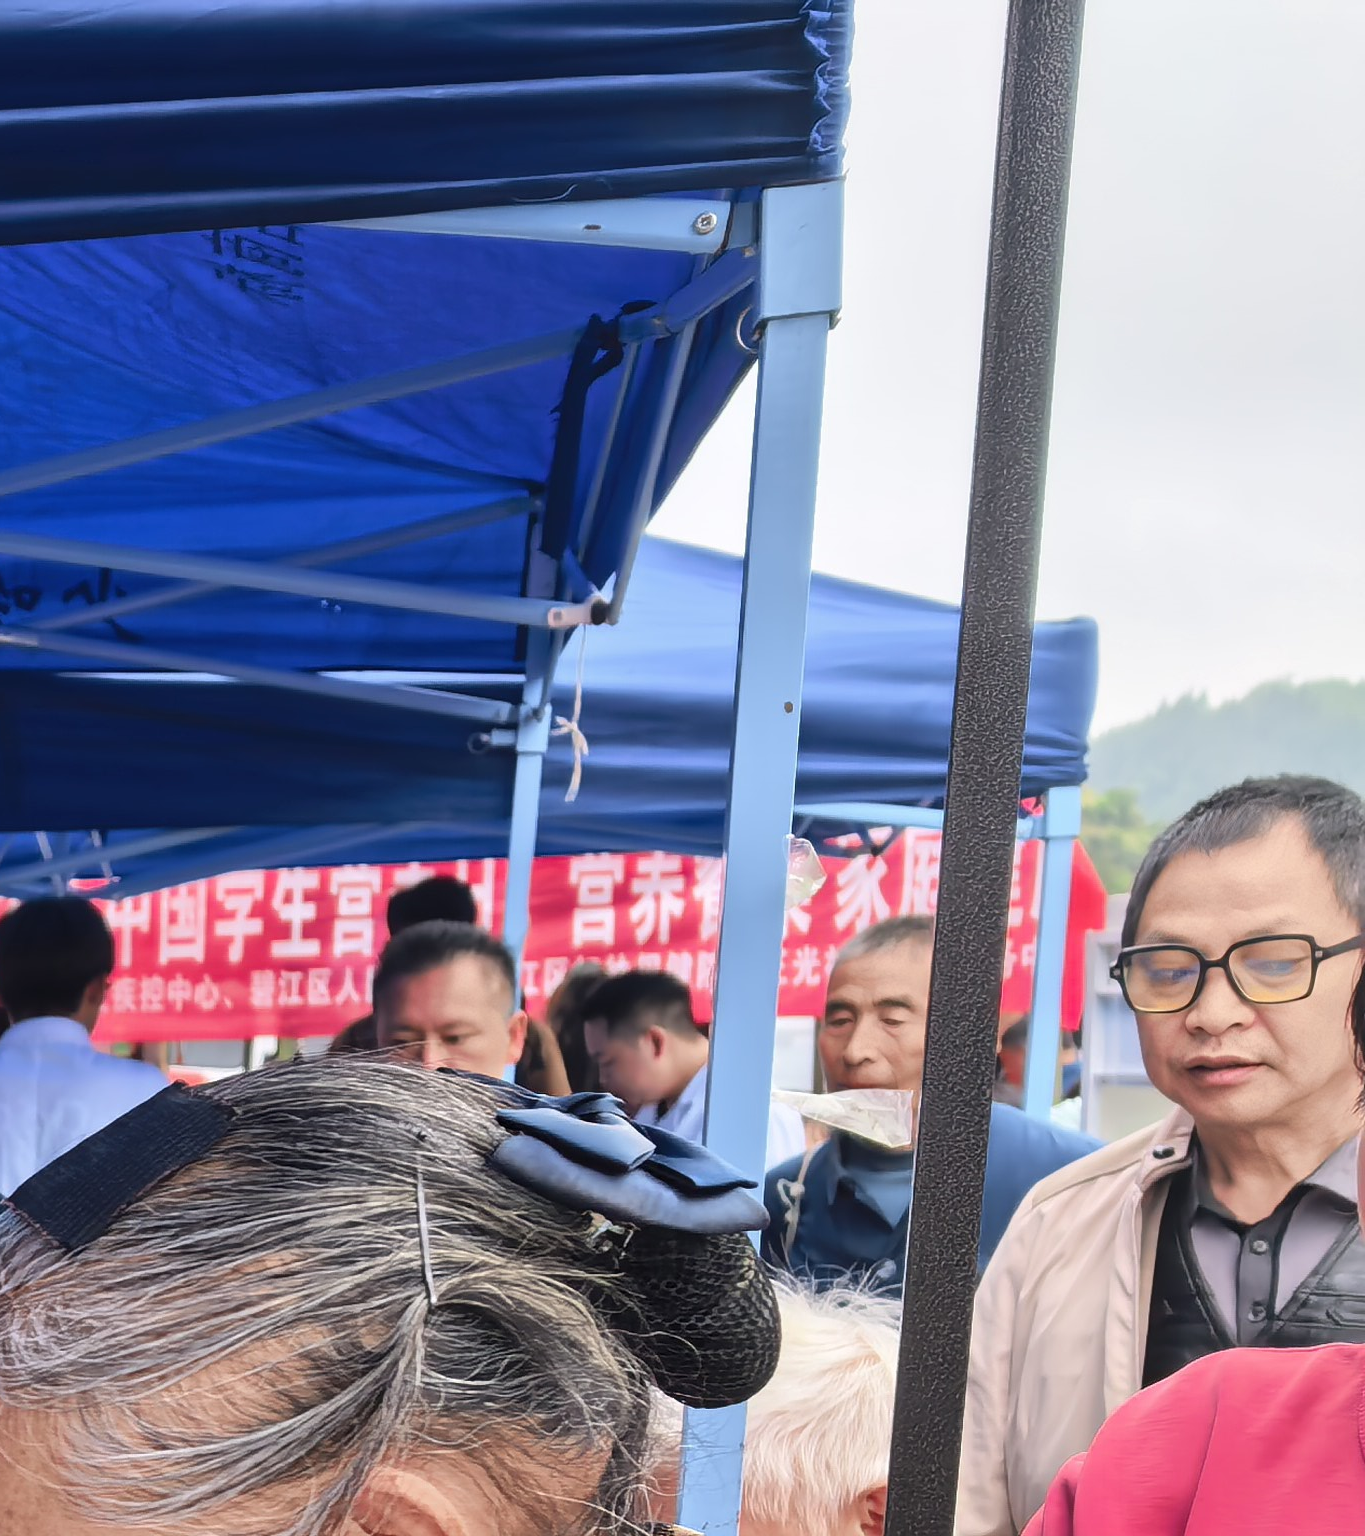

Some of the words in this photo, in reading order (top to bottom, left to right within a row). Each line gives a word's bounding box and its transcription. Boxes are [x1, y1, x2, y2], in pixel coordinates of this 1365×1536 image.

[105, 858, 496, 967] 中国学生营
